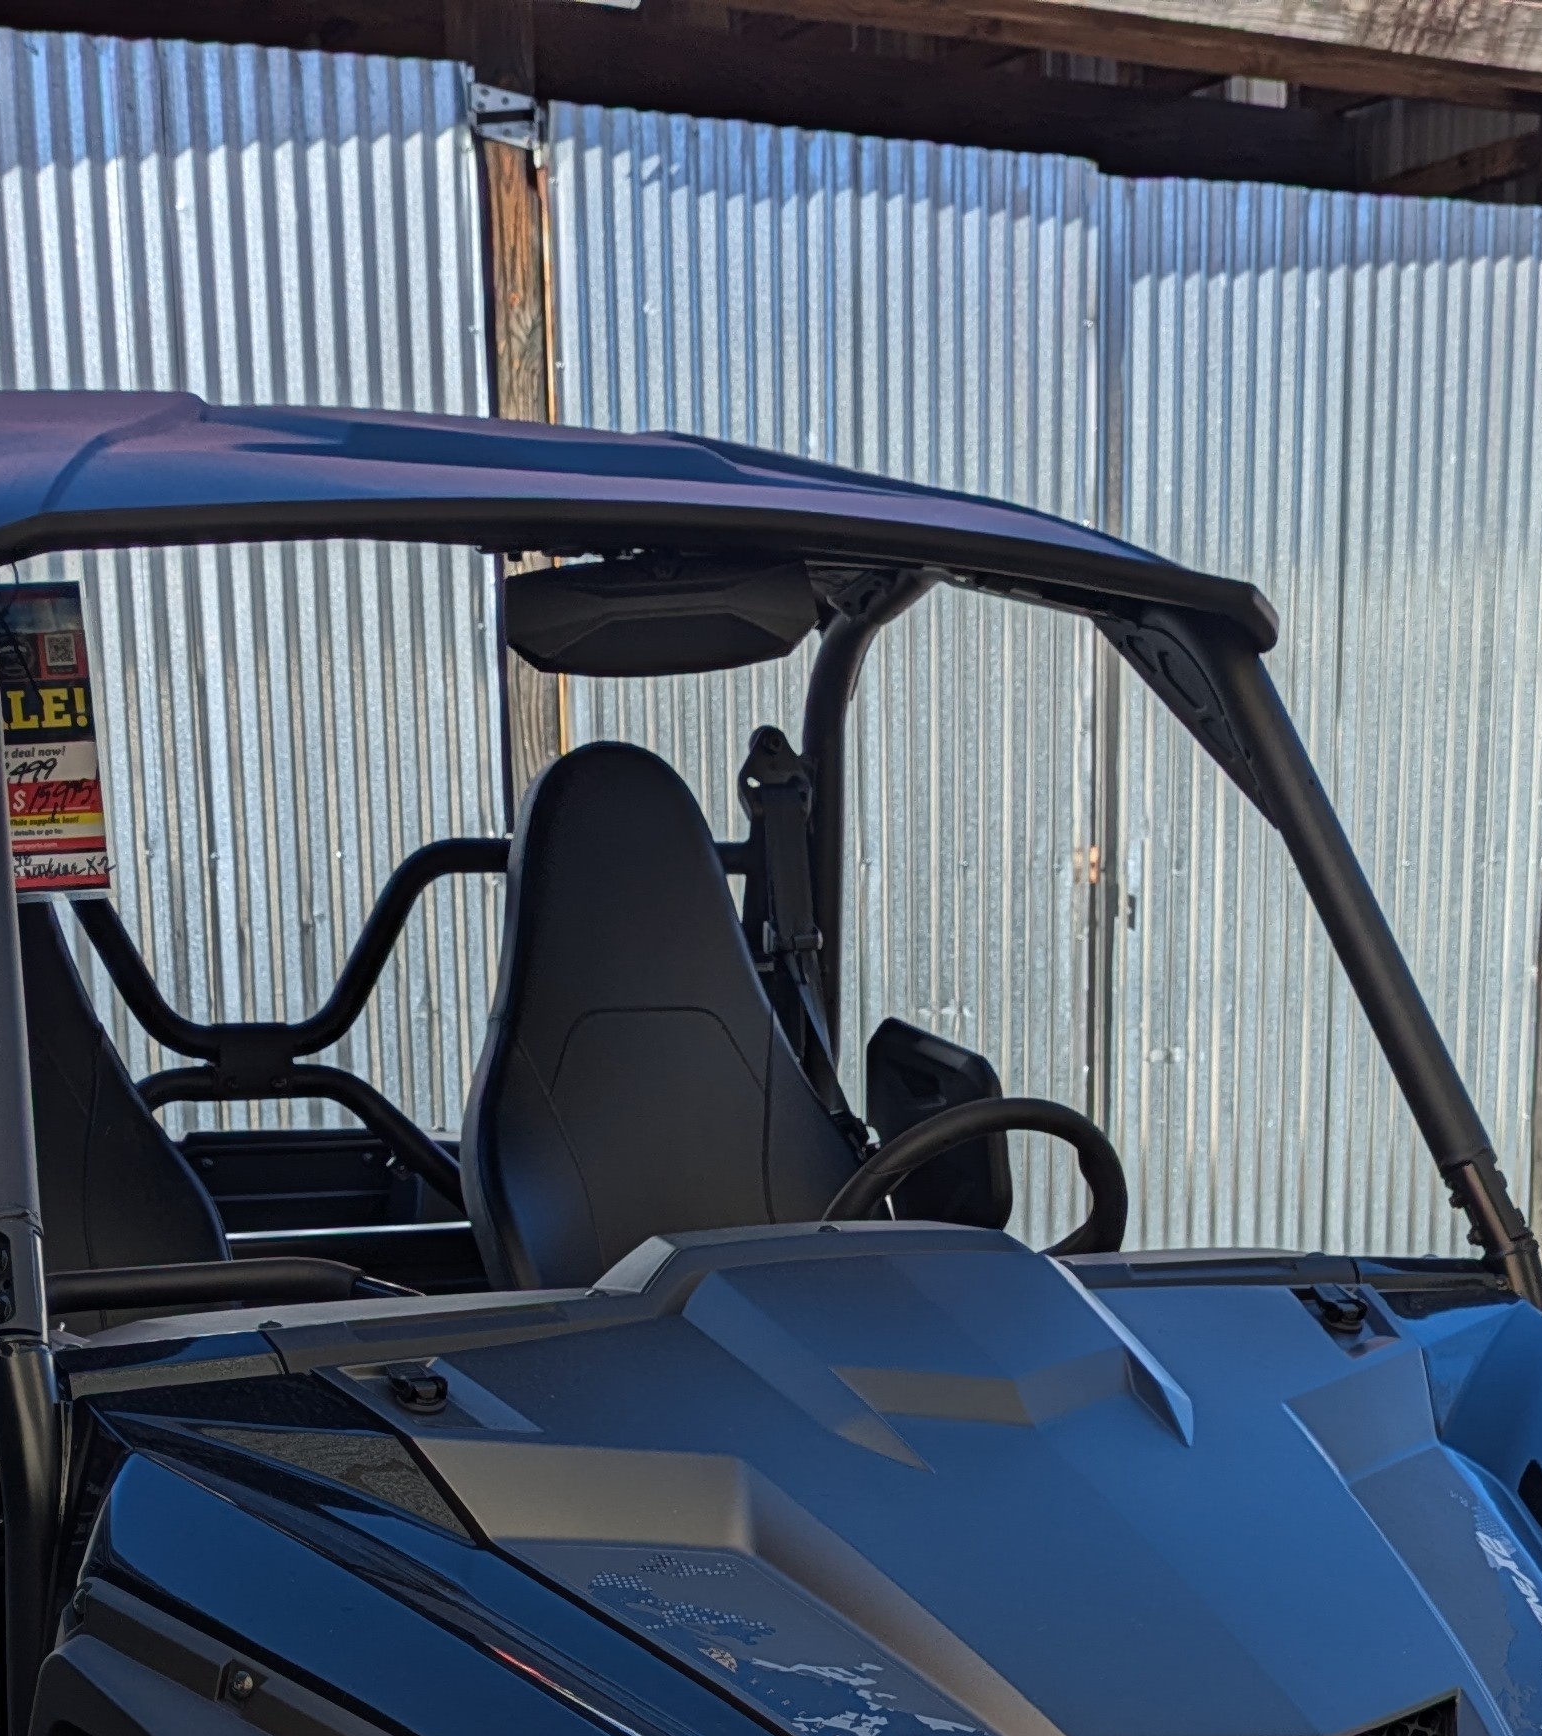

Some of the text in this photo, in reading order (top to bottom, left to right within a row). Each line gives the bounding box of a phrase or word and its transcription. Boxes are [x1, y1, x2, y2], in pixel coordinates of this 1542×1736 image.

[4, 687, 88, 730] LE!
[11, 747, 34, 758] deal
[38, 746, 66, 756] now!
